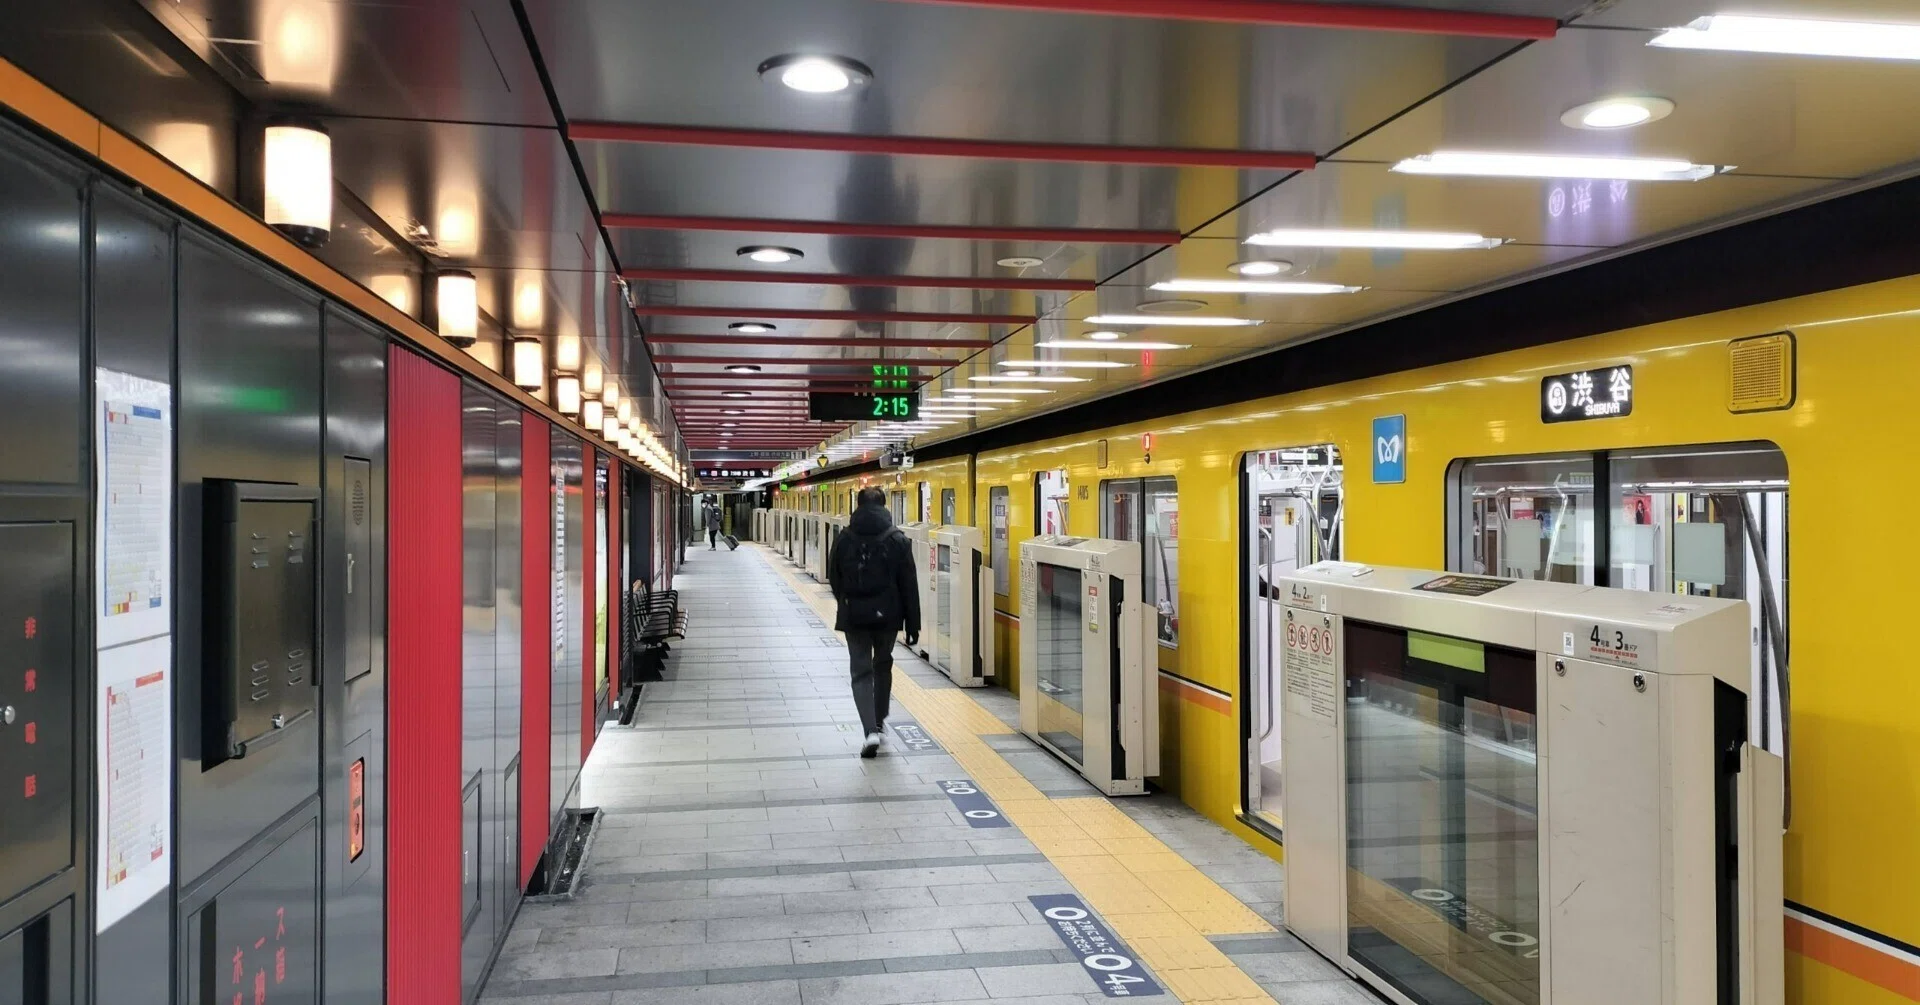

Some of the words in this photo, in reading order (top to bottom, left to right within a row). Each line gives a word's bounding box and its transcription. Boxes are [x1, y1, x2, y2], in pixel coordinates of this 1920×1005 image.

[1571, 368, 1631, 407] 渋谷
[873, 397, 909, 416] 2:15
[1585, 402, 1620, 416] SHIBUYA
